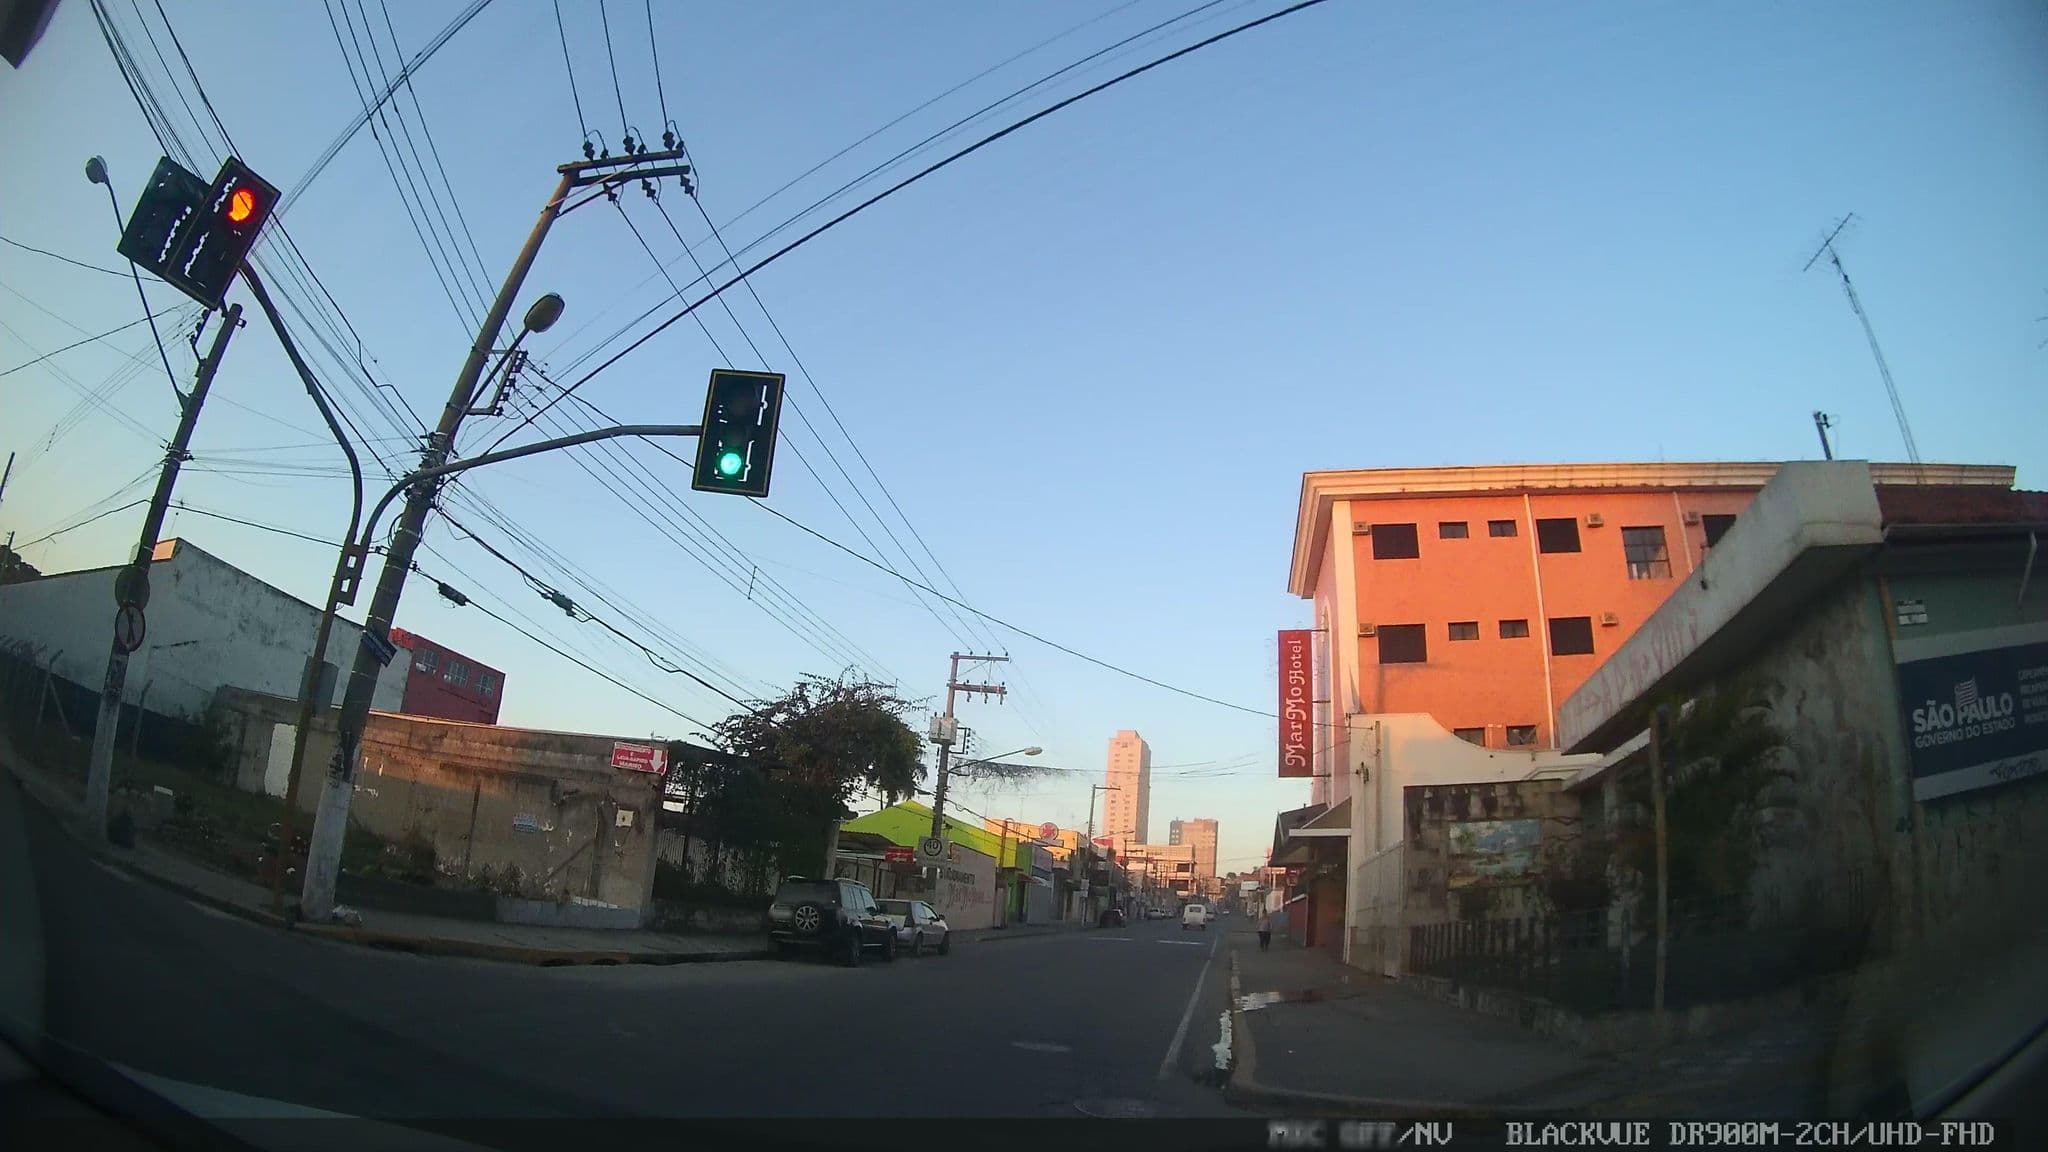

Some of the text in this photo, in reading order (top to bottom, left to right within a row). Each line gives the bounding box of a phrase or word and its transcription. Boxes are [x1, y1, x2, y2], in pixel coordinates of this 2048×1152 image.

[1913, 700, 1954, 733] SÃO
[1956, 693, 2013, 726] PAULO
[1915, 717, 2015, 749] GOVERNO DO ESTADO
[927, 841, 939, 850] 40
